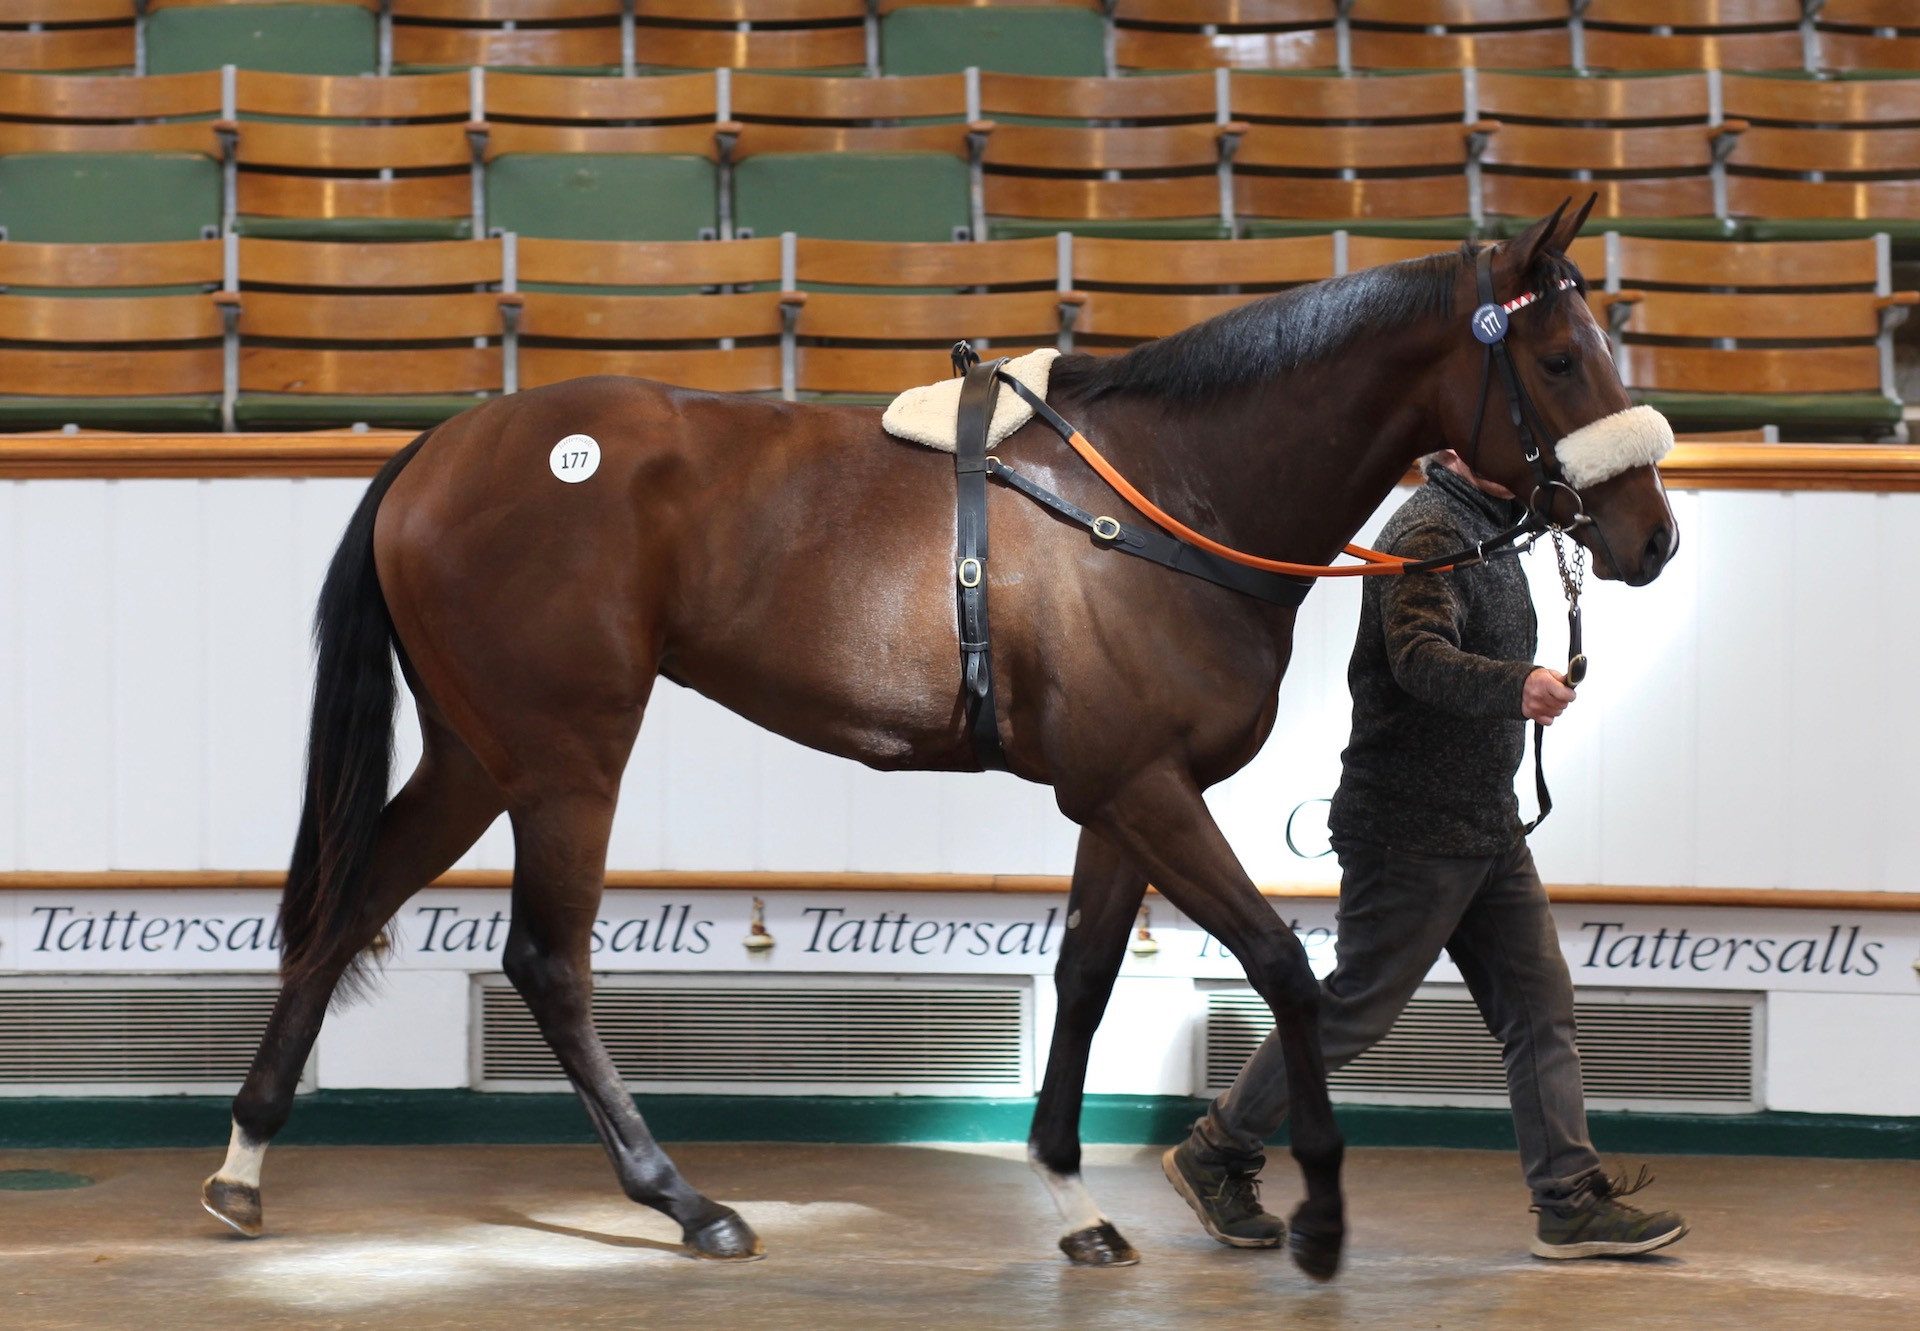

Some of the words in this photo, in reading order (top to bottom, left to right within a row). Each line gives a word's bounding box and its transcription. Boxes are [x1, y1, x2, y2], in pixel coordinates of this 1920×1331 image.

[1480, 311, 1502, 337] 177
[562, 452, 588, 469] 177
[32, 904, 281, 952] Tattersal
[417, 904, 714, 954] Tatsalls
[802, 906, 1059, 956] Tattersal
[1580, 921, 1884, 976] Tattersalls
